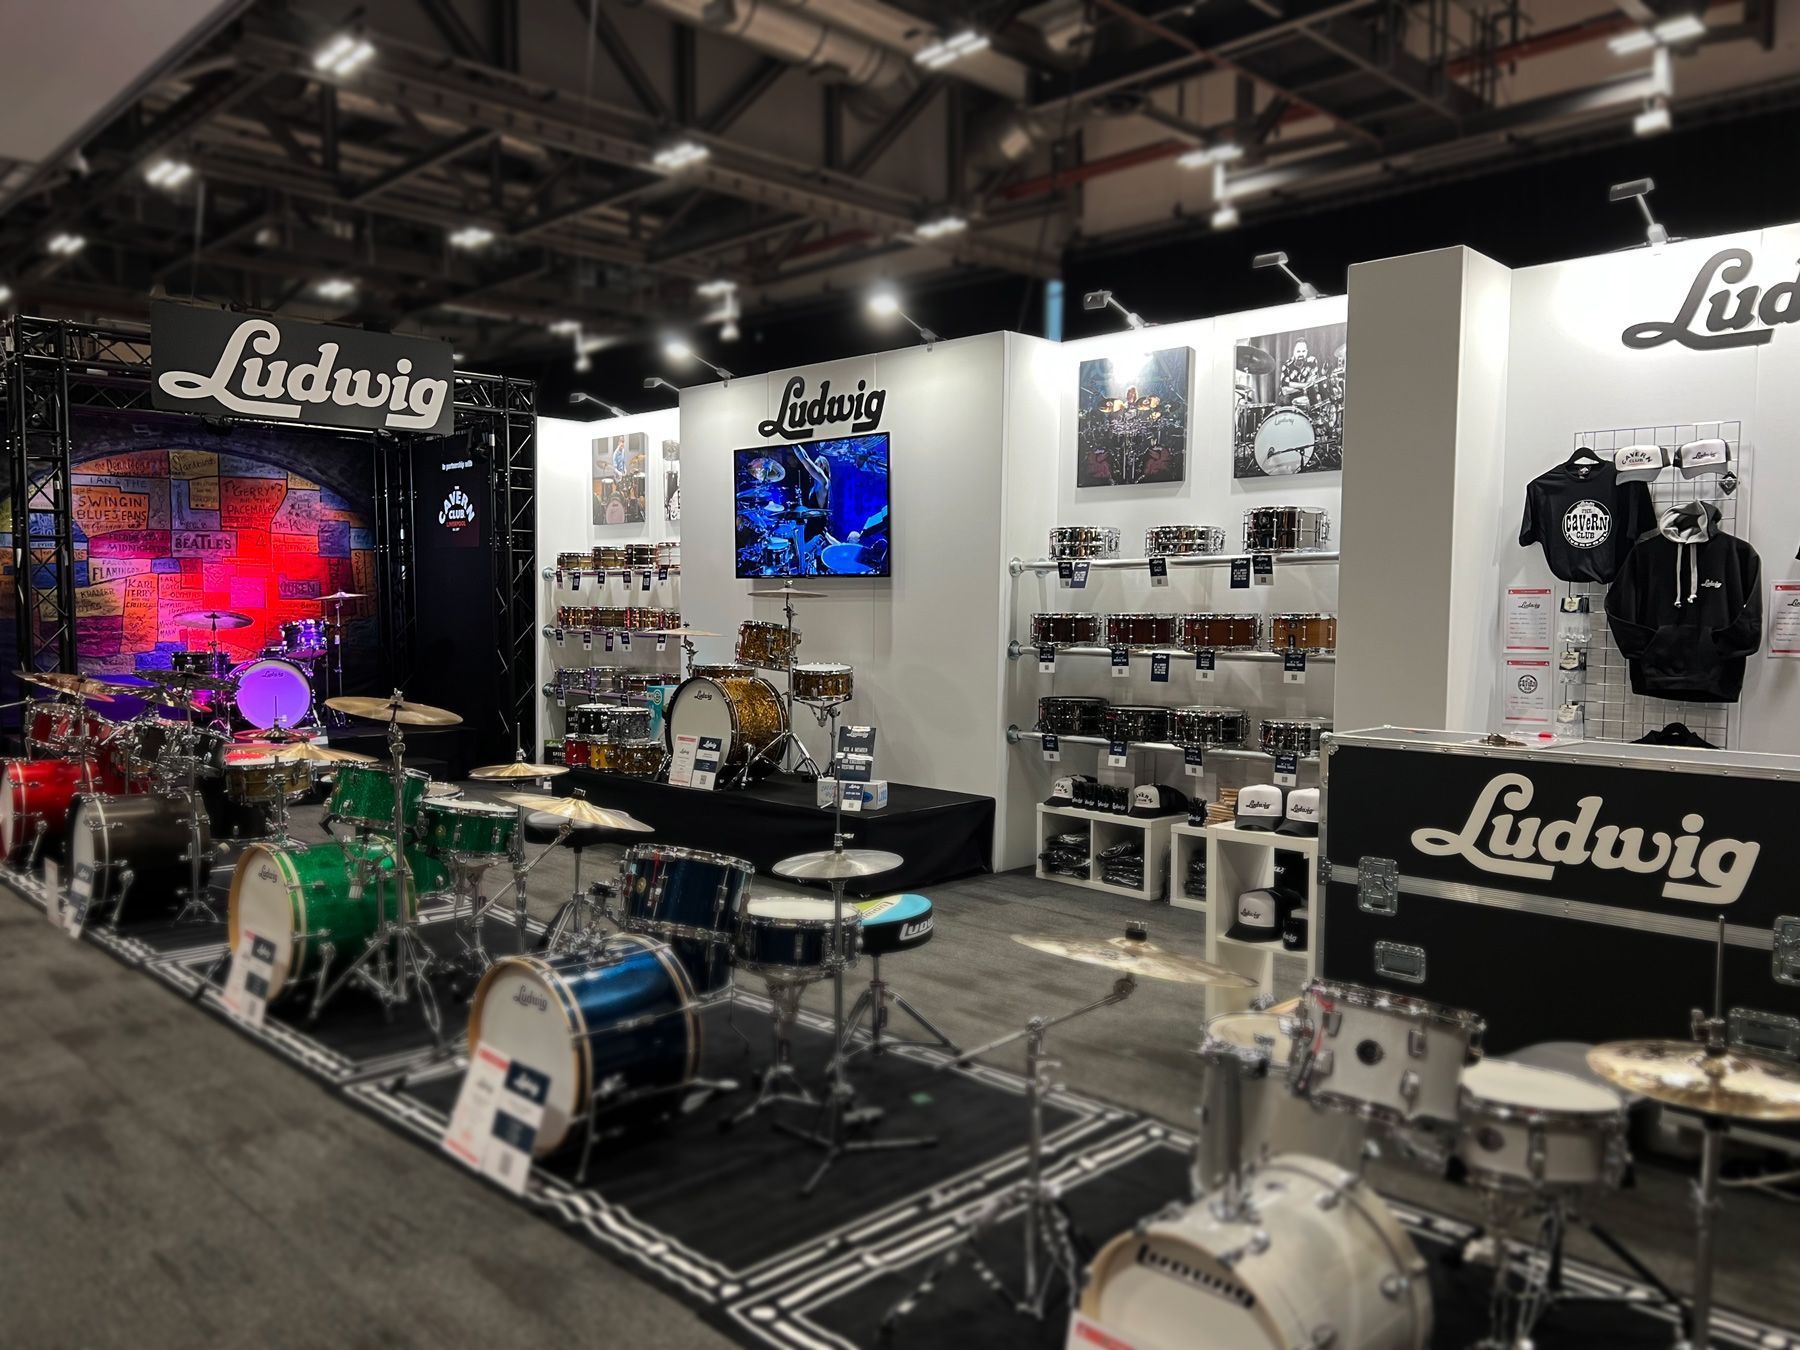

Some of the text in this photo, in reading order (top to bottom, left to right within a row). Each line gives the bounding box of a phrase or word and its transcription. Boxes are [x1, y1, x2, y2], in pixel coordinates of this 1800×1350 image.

[158, 319, 448, 429] Ludwig
[758, 376, 887, 440] Ludwig
[1621, 451, 1653, 465] CAVERN
[438, 490, 475, 524] CAVERN
[448, 509, 465, 520] CLUB
[175, 533, 232, 550] BEATLES
[1576, 531, 1595, 539] CLUB
[693, 690, 713, 701] Ludwig
[1410, 772, 1761, 905] Ludwig
[258, 864, 278, 884] Ludwig
[512, 984, 548, 1012] Ludwig
